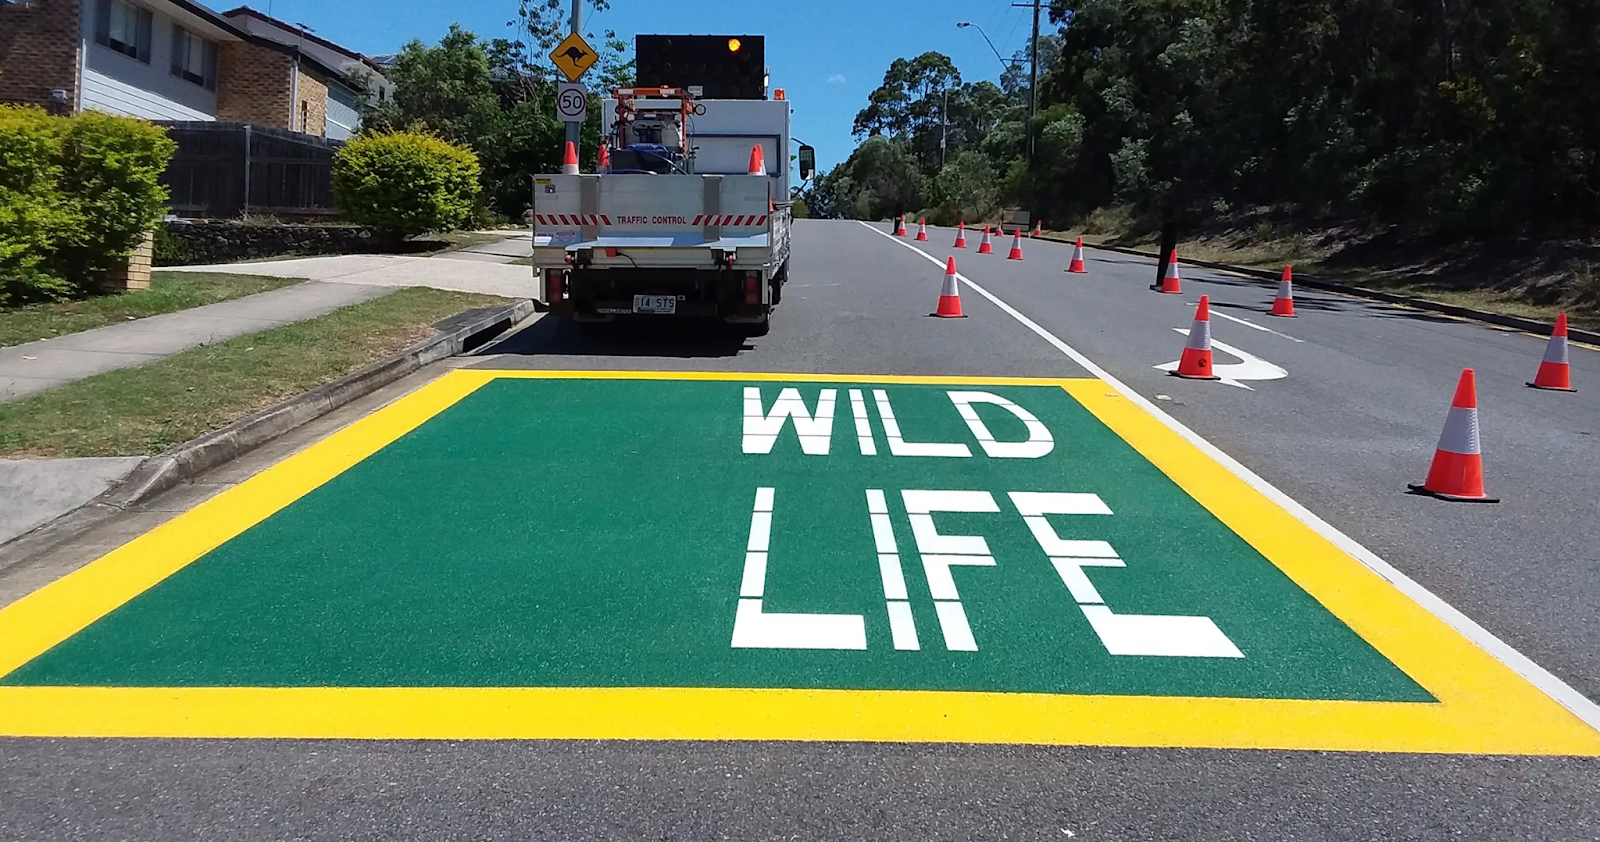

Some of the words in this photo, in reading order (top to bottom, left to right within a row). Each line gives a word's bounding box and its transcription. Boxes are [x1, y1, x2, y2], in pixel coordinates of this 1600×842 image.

[562, 95, 582, 109] 50
[616, 215, 648, 225] TRAFFIC
[651, 215, 687, 225] CONTROL
[656, 298, 675, 308] STS
[741, 386, 1055, 459] WILD
[731, 487, 1246, 658] LIFE
